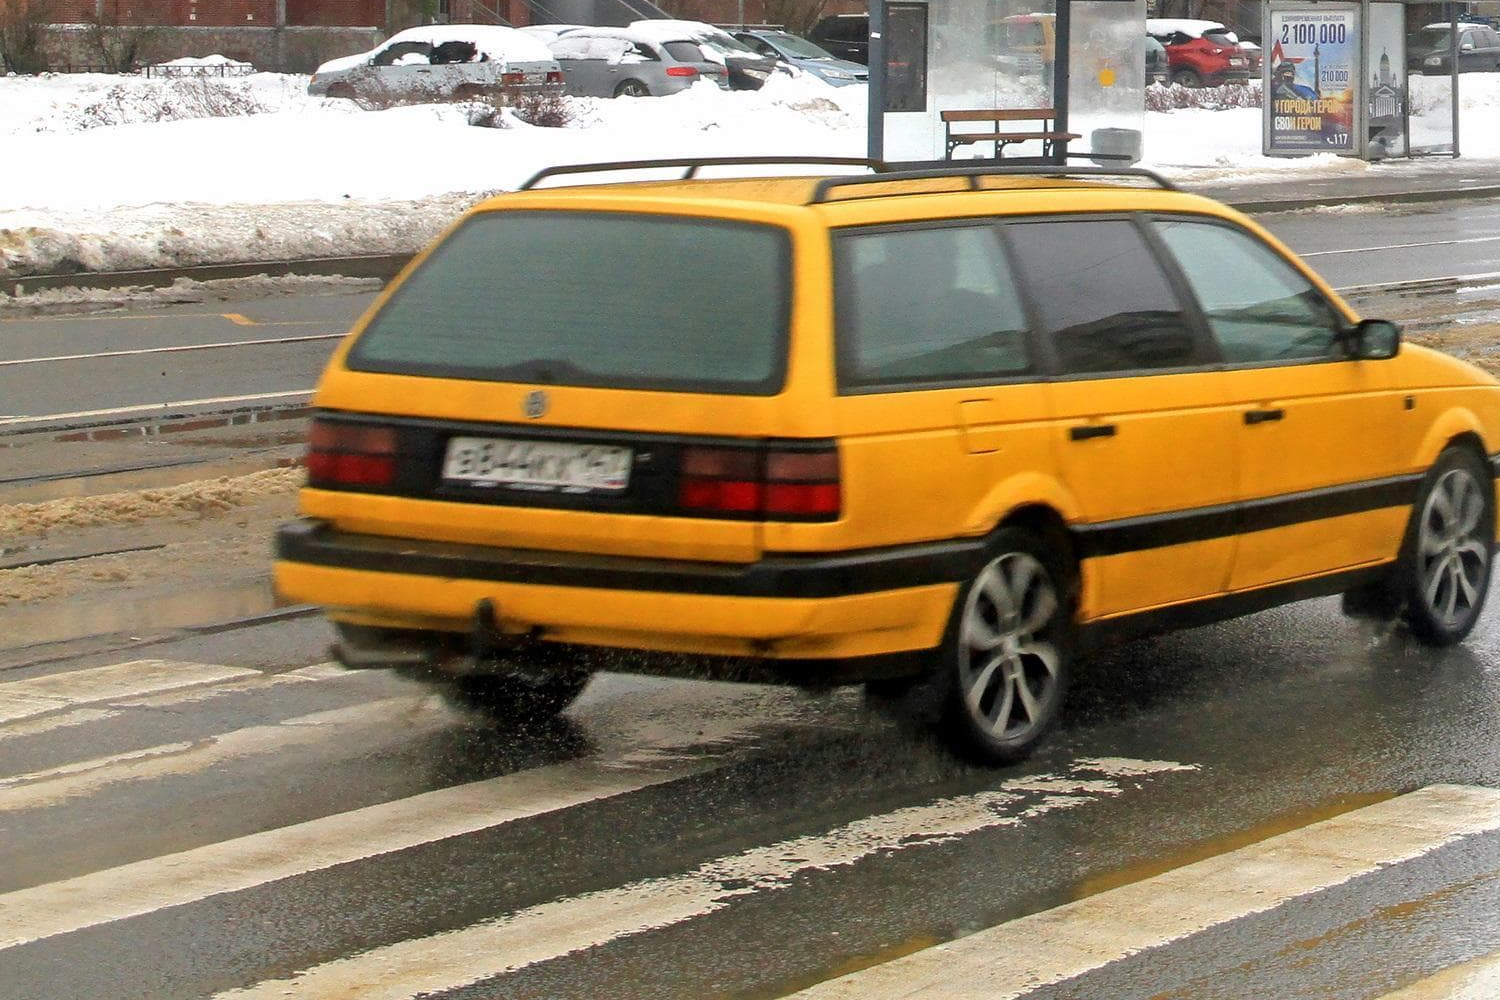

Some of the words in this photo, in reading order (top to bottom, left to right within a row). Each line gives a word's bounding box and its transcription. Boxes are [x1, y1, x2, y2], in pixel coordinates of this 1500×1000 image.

[1281, 24, 1289, 44] 2
[1293, 23, 1315, 44] 100
[1320, 23, 1346, 44] 000
[1321, 70, 1334, 82] 210
[1335, 70, 1349, 82] 000
[1275, 116, 1296, 130] СВОИ
[1297, 116, 1322, 130] ГЕРОИ
[1334, 133, 1348, 145] 117
